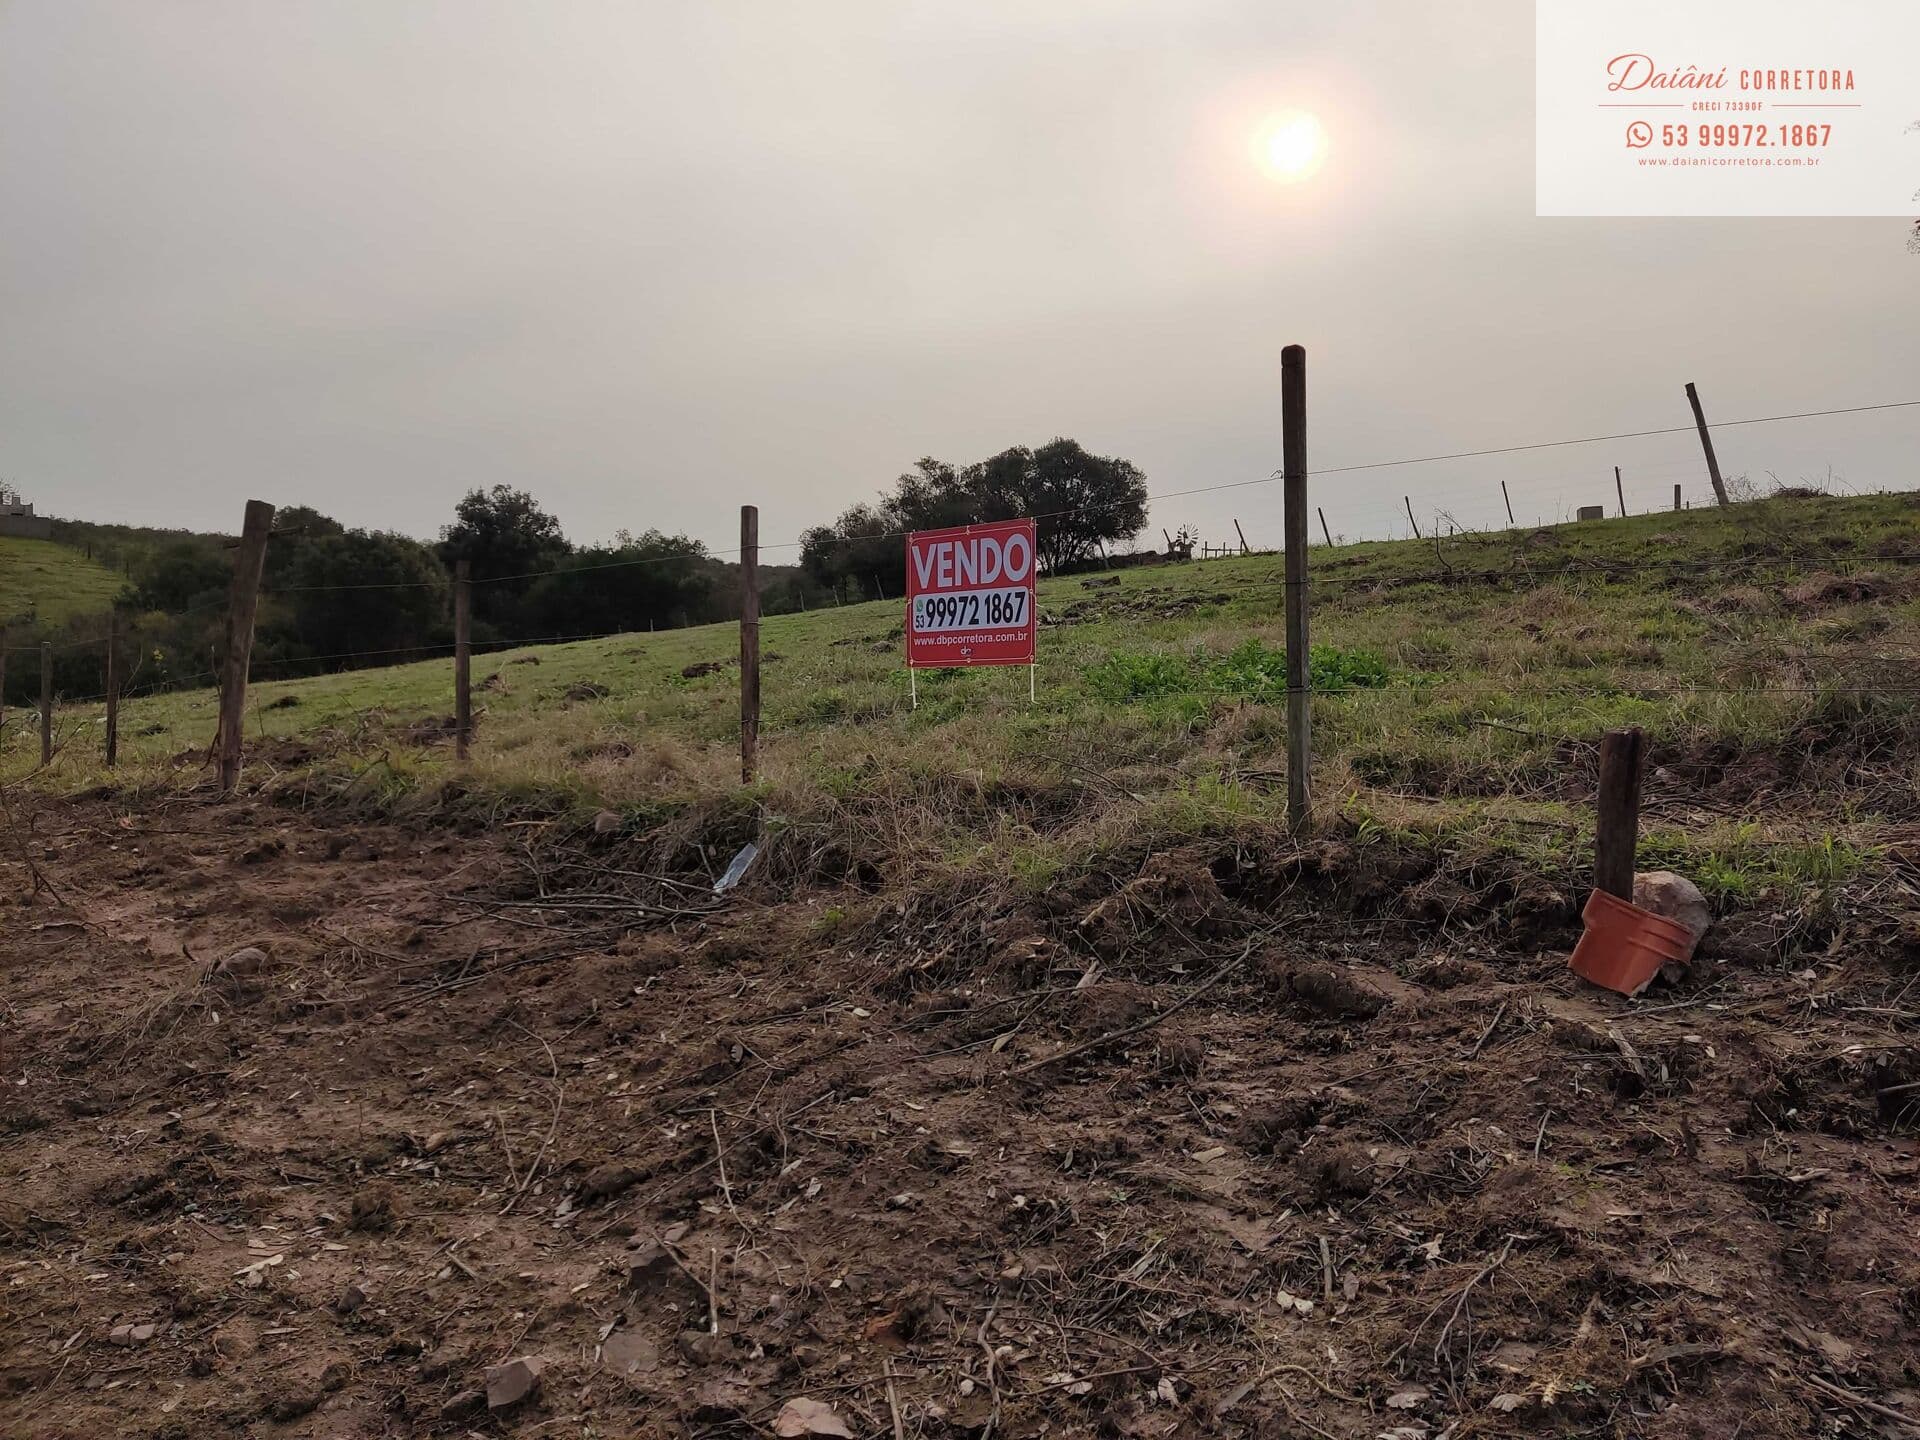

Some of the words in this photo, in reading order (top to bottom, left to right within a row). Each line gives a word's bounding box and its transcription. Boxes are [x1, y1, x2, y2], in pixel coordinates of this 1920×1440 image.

[912, 533, 1031, 589] VENDO
[915, 614, 925, 629] 53
[926, 596, 979, 628] 99972
[985, 591, 1025, 624] 1867
[914, 631, 1027, 646] www.dbpcorretora.com.br
